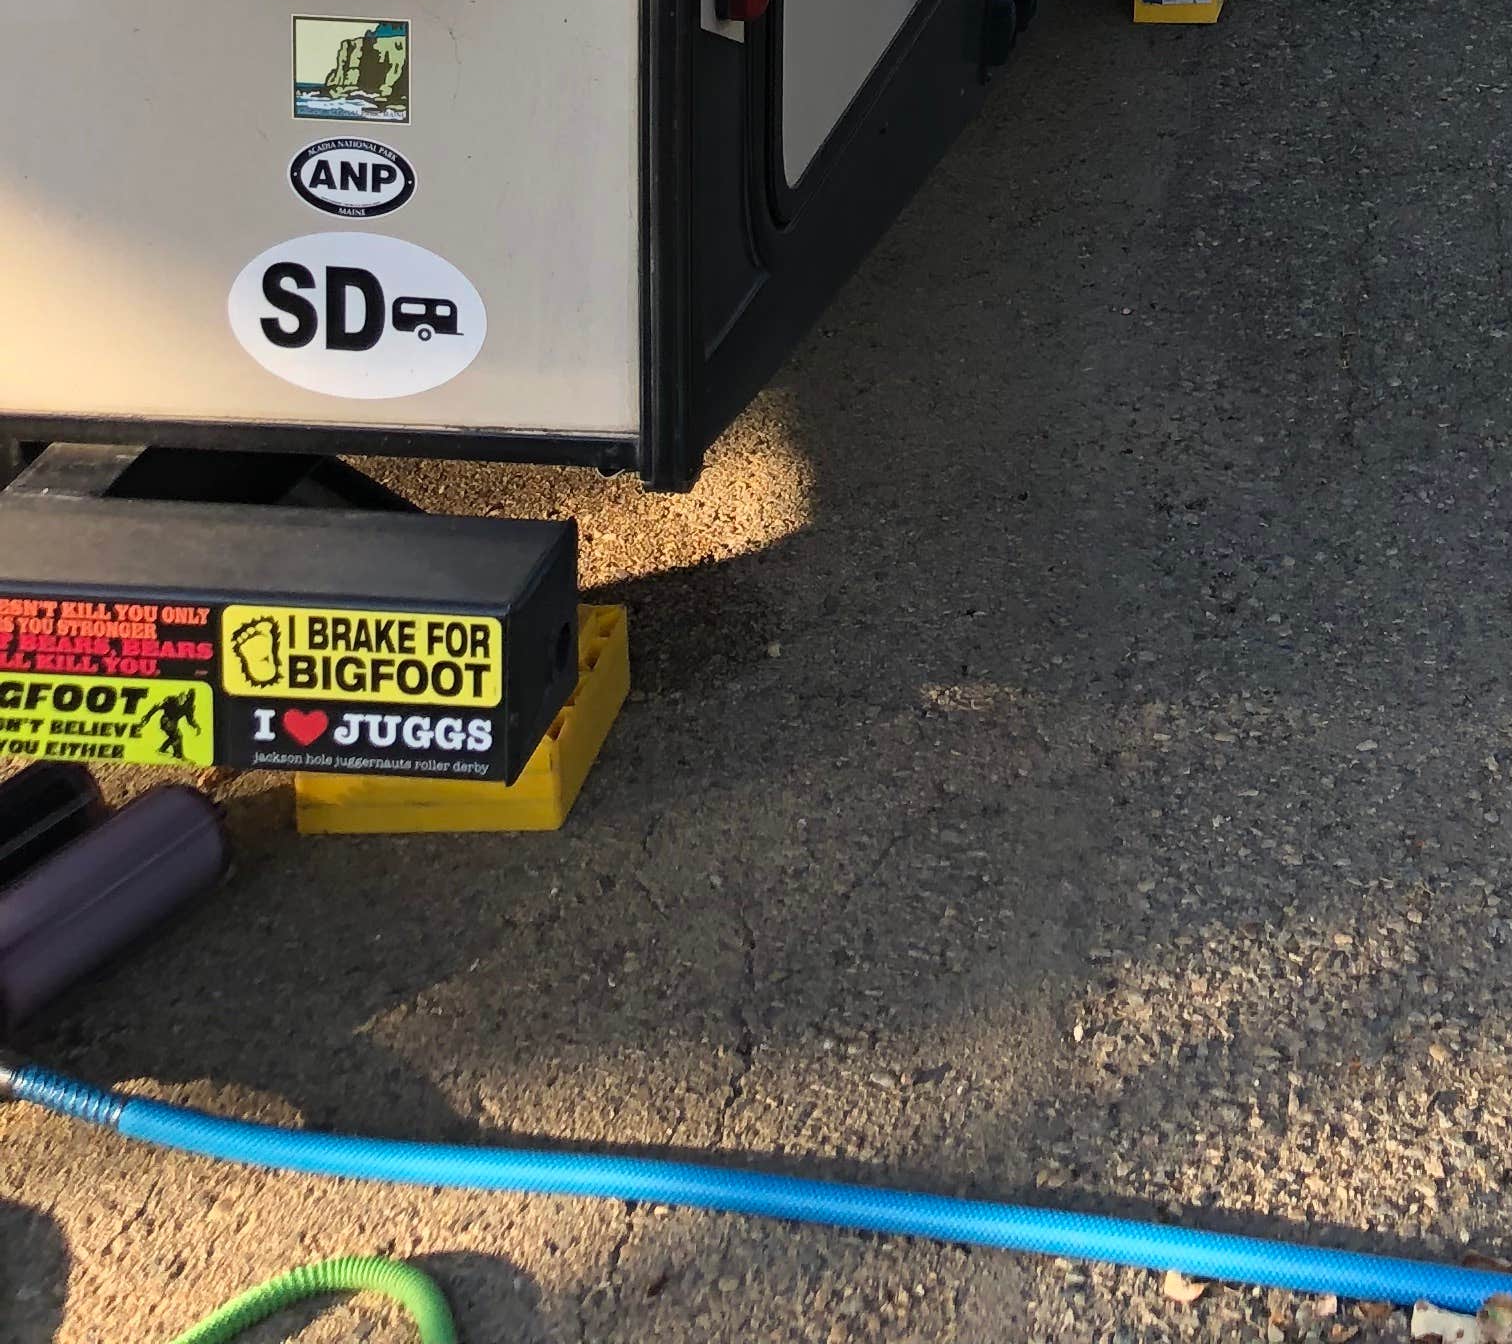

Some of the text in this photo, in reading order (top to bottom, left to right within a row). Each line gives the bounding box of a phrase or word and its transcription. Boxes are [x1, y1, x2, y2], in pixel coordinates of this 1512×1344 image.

[307, 140, 397, 162] ACADIA NATIONAL PARK
[308, 159, 397, 193] ANP
[338, 207, 366, 216] MAINE
[260, 261, 386, 352] SD
[60, 600, 111, 620] KILL
[115, 603, 159, 623] YOU
[161, 606, 210, 626] ONLY
[17, 617, 54, 635] YOU
[57, 618, 158, 640] STRONGER
[288, 615, 491, 658] I BRAKE FOR
[19, 633, 117, 657] BEARS,
[122, 638, 214, 660] BEARS
[35, 653, 99, 674] KILL
[288, 654, 491, 698] BIGFOOT
[50, 719, 143, 739] BELIEVE
[253, 708, 493, 752] I JUGGS
[45, 741, 125, 758] EITHER
[253, 751, 490, 775] jackson hole juggernauts roller derby
